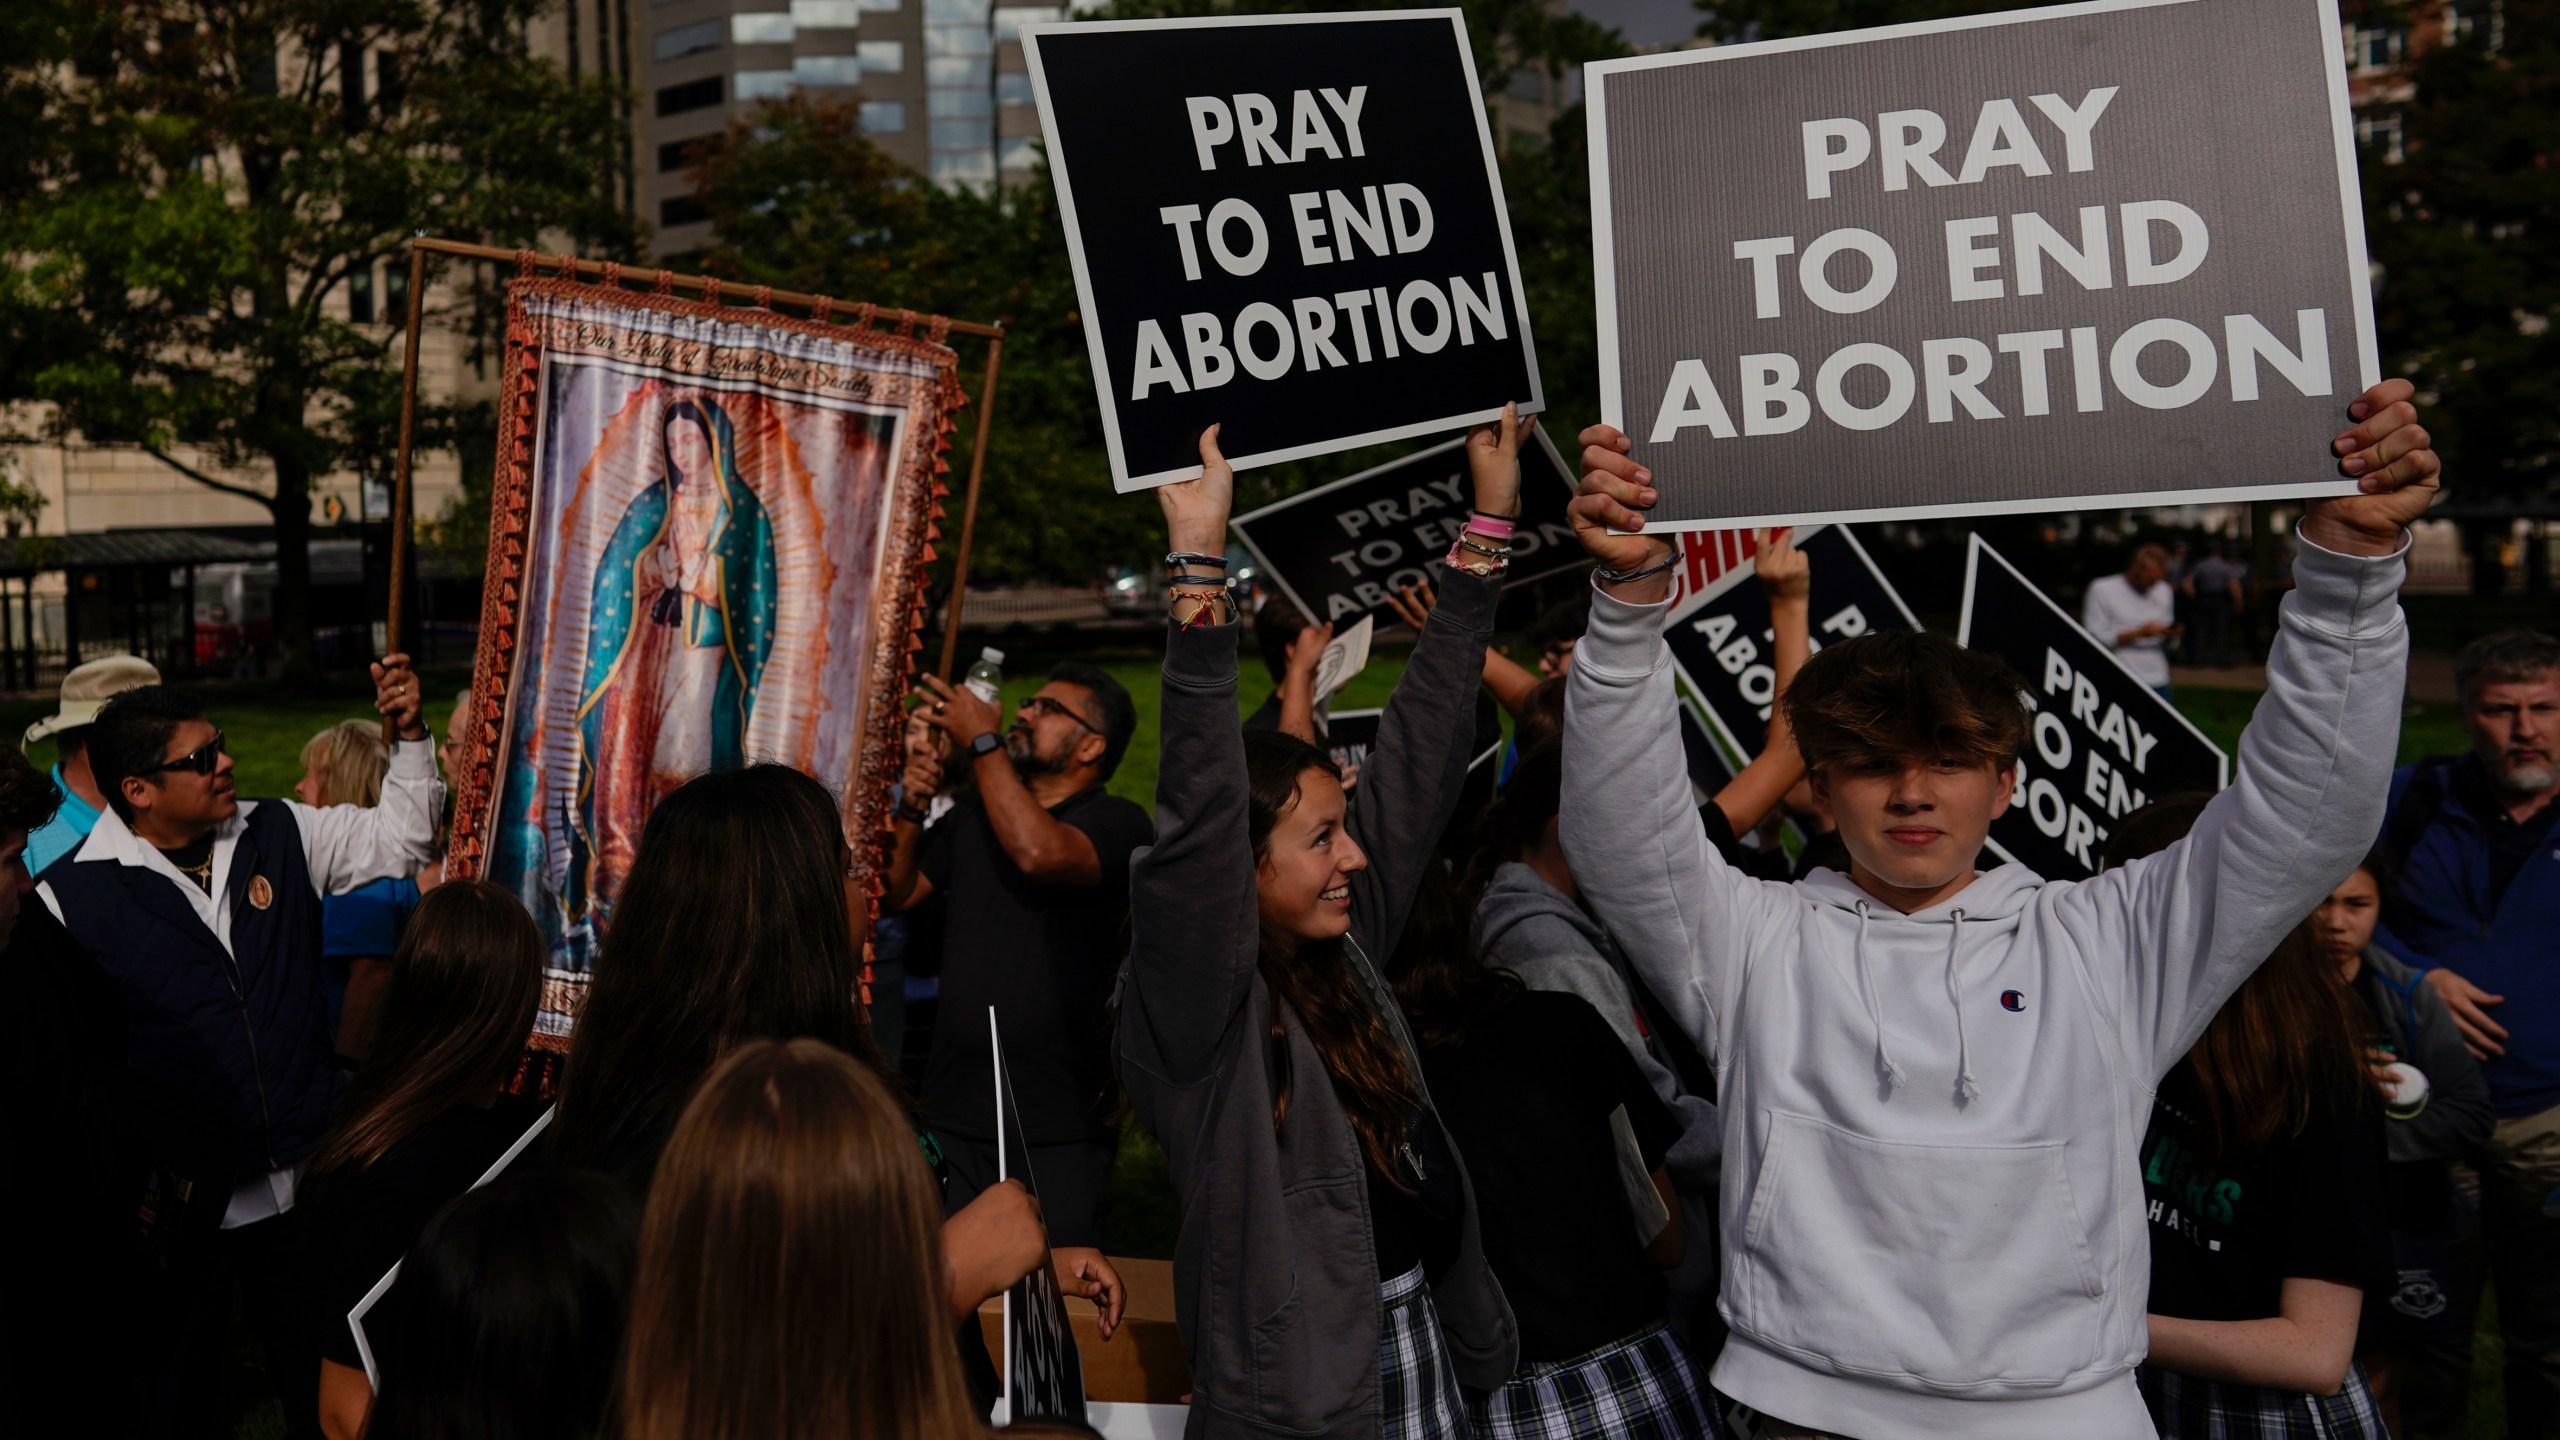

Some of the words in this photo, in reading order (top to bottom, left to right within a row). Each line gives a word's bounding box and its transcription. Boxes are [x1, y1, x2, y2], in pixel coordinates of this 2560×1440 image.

[1185, 85, 1368, 171] PRAY
[1801, 85, 2120, 200] PRAY
[1160, 197, 1269, 281] TO
[1289, 182, 1434, 266] END
[1734, 227, 1898, 319] TO
[1945, 199, 2209, 302] END
[619, 330, 674, 369] Lady
[680, 343, 701, 374] of
[1131, 271, 1508, 401] ABORTION
[1649, 308, 2334, 442] ABORTION
[1329, 537, 1404, 578] TO
[1413, 508, 1476, 552] EN
[1334, 471, 1465, 540] PRAY
[1668, 526, 1793, 612] HIL
[2043, 645, 2159, 775] PRAY
[2084, 748, 2154, 821] EN
